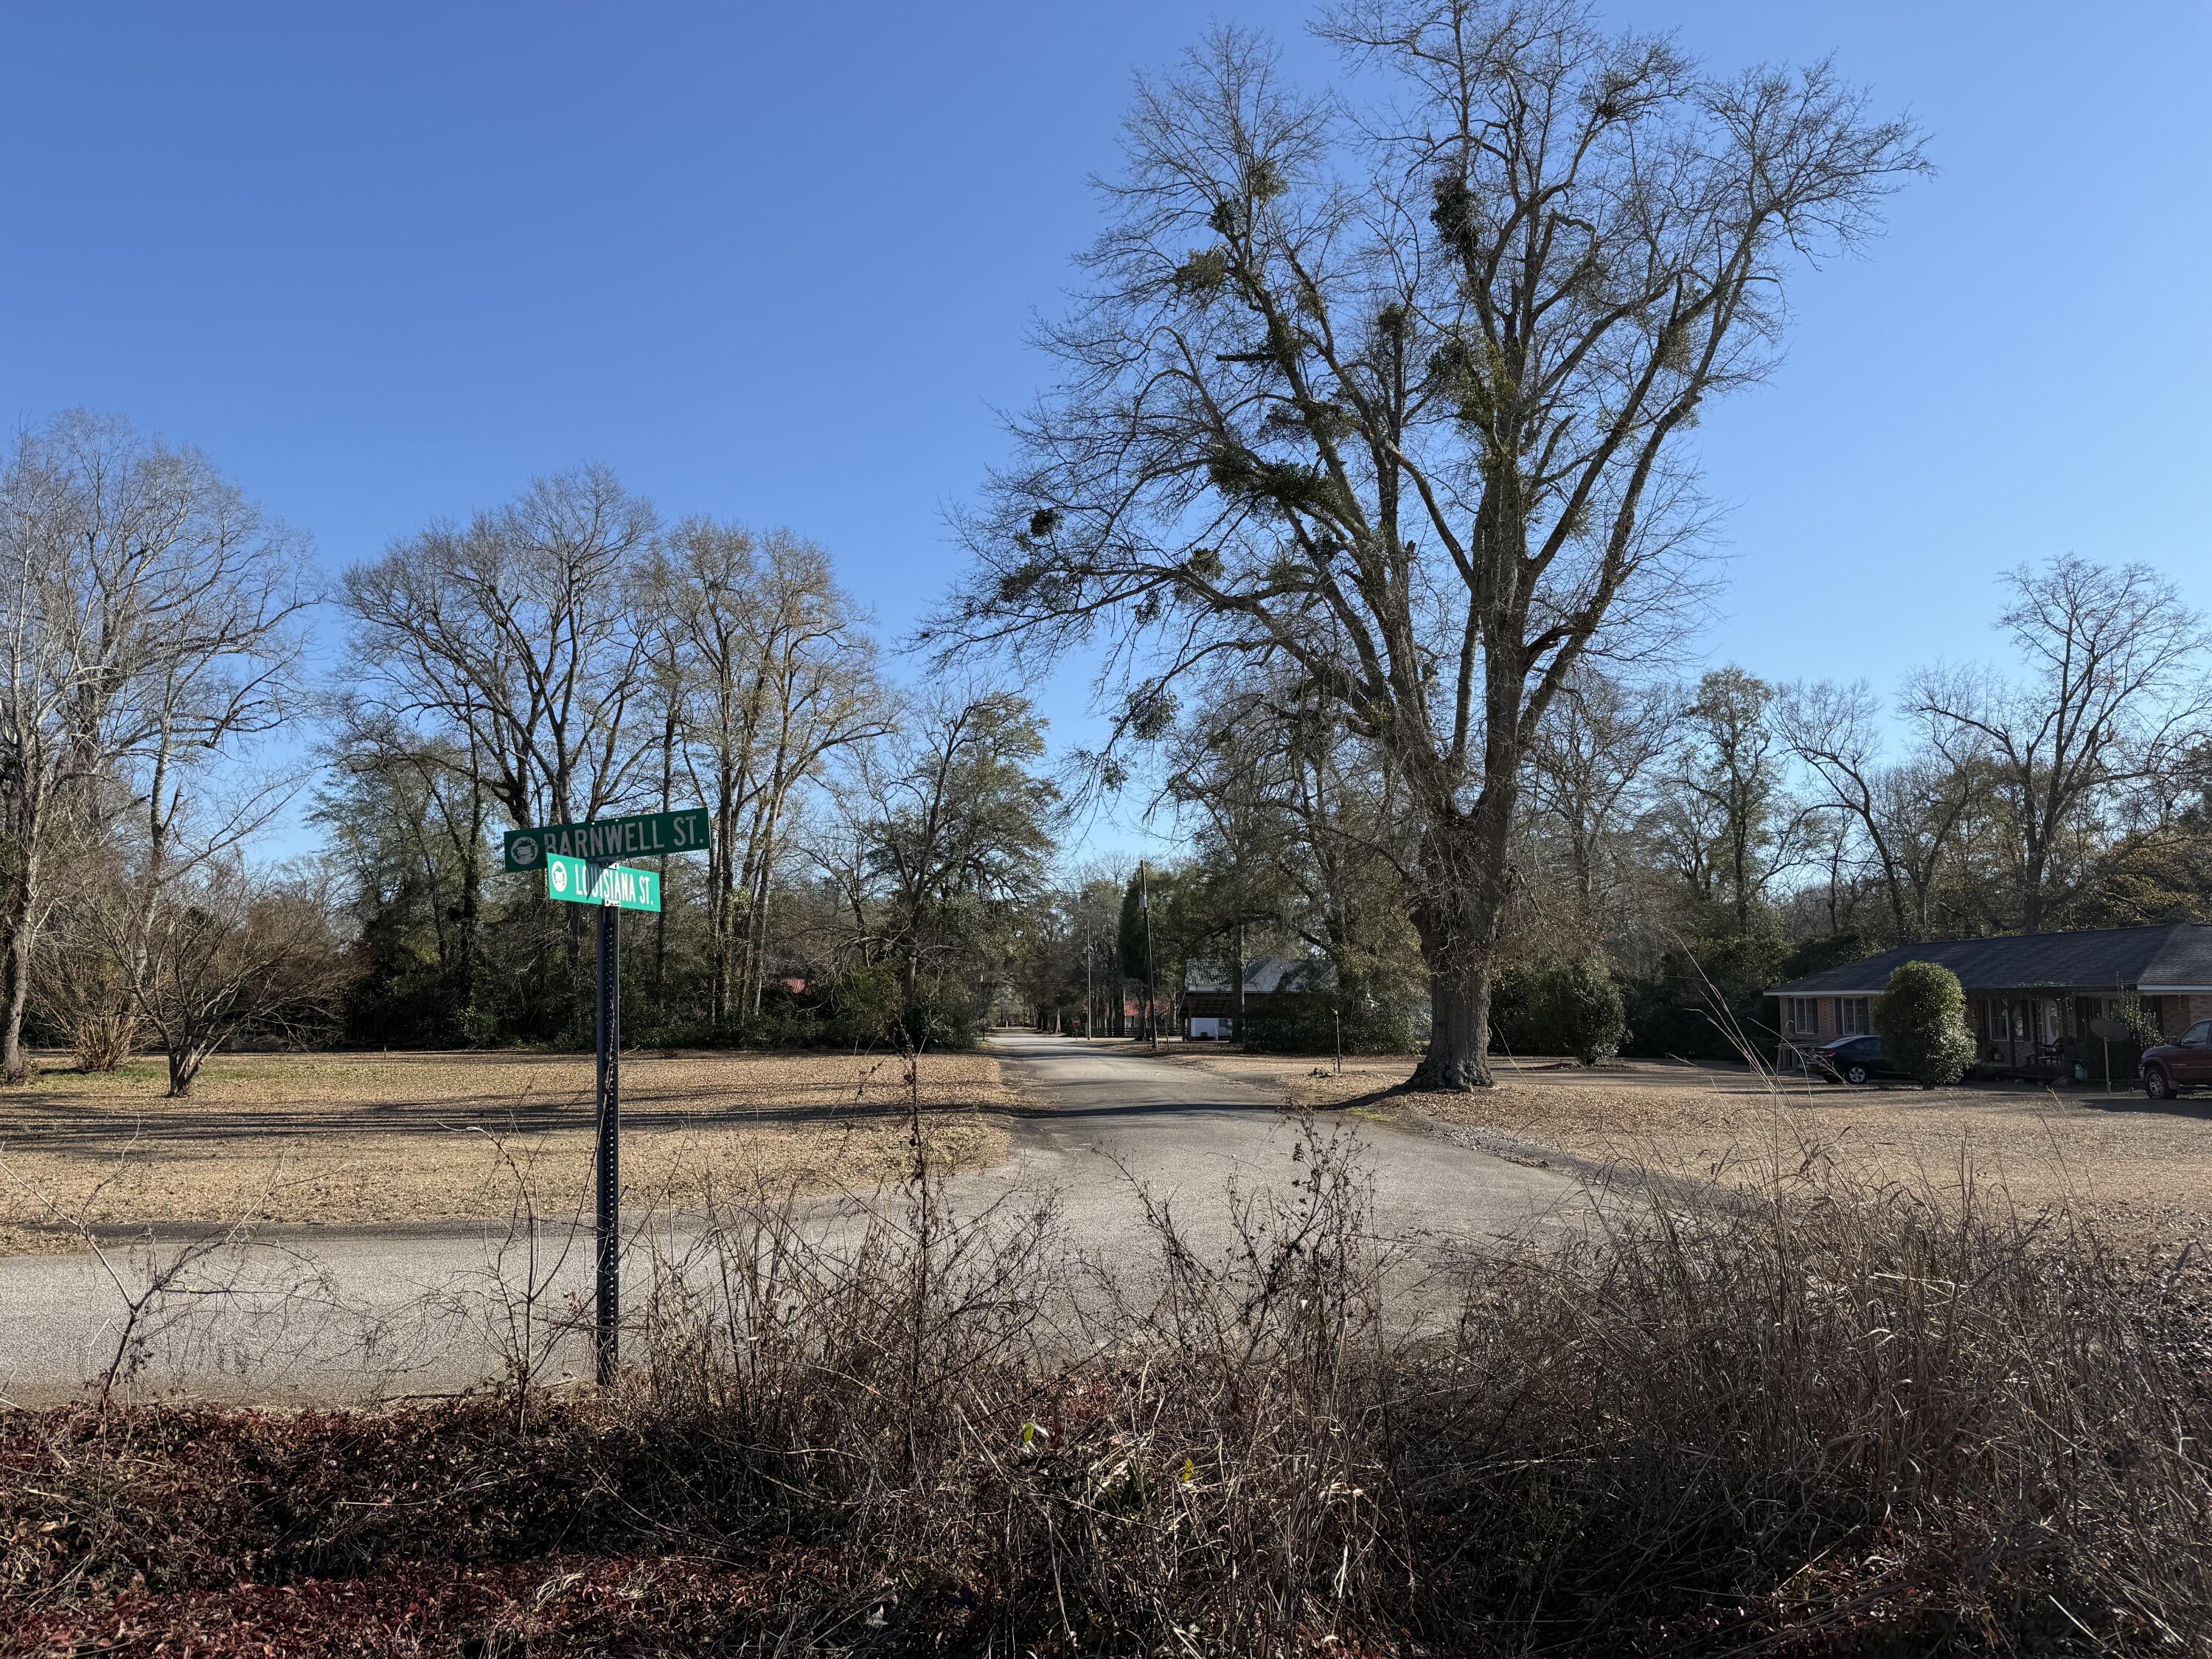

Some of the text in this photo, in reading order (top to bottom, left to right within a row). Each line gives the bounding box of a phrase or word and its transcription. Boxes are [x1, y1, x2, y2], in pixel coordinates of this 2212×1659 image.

[544, 815, 704, 858] BARNWELL ST.
[574, 863, 654, 905] LOUISIANA ST.
